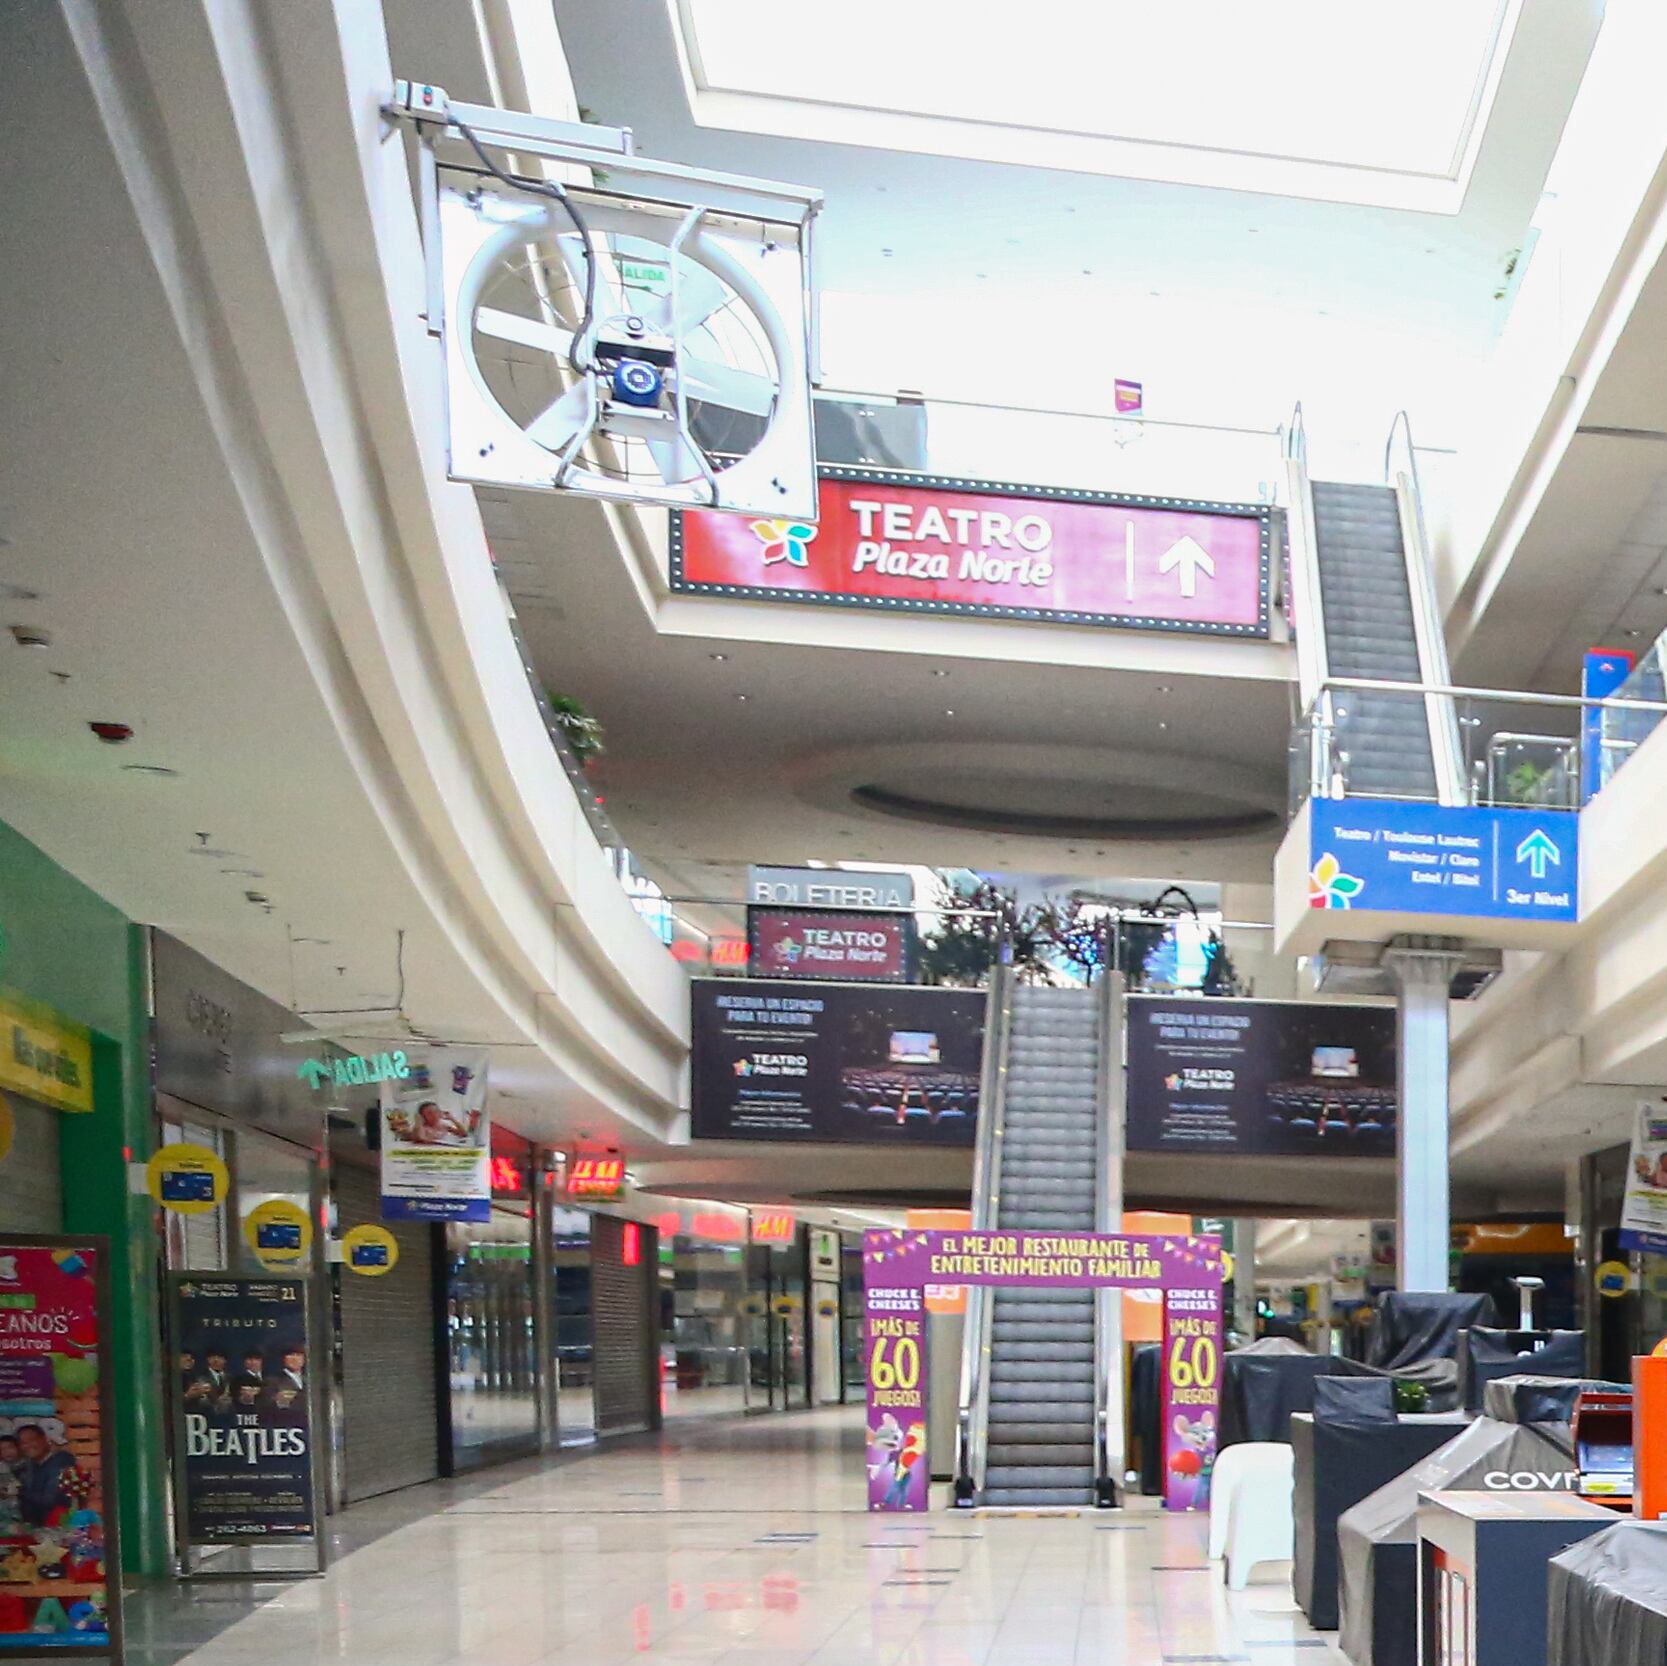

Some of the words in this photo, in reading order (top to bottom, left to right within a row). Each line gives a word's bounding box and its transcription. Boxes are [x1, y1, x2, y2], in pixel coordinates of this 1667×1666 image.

[850, 500, 1052, 552] TEATRO
[853, 541, 950, 580] Plaza
[958, 550, 1053, 587] Norte
[1506, 888, 1531, 905] 3er
[1534, 891, 1569, 907] Nivel
[803, 928, 887, 947] TEATRO
[804, 945, 845, 960] Plaza
[847, 949, 888, 963] Norte
[752, 1054, 808, 1066] TEATRO
[1182, 1068, 1235, 1081] TEATRO
[942, 1238, 957, 1253] EL
[962, 1236, 1017, 1255] MEJOR
[1023, 1237, 1129, 1259] RESTAURANTE
[1133, 1243, 1149, 1258] DE
[931, 1255, 1083, 1276] ENTRETENIMIENTO
[1088, 1259, 1161, 1279] FAMILIAR
[281, 1287, 296, 1300] 21
[868, 1288, 908, 1298] CHUCK
[1167, 1289, 1206, 1299] CHUCK
[202, 1319, 278, 1328] TRIBUTO
[871, 1337, 919, 1389] 60
[1170, 1337, 1217, 1388] 60
[236, 1414, 259, 1425] THE
[185, 1414, 305, 1464] BEATLES
